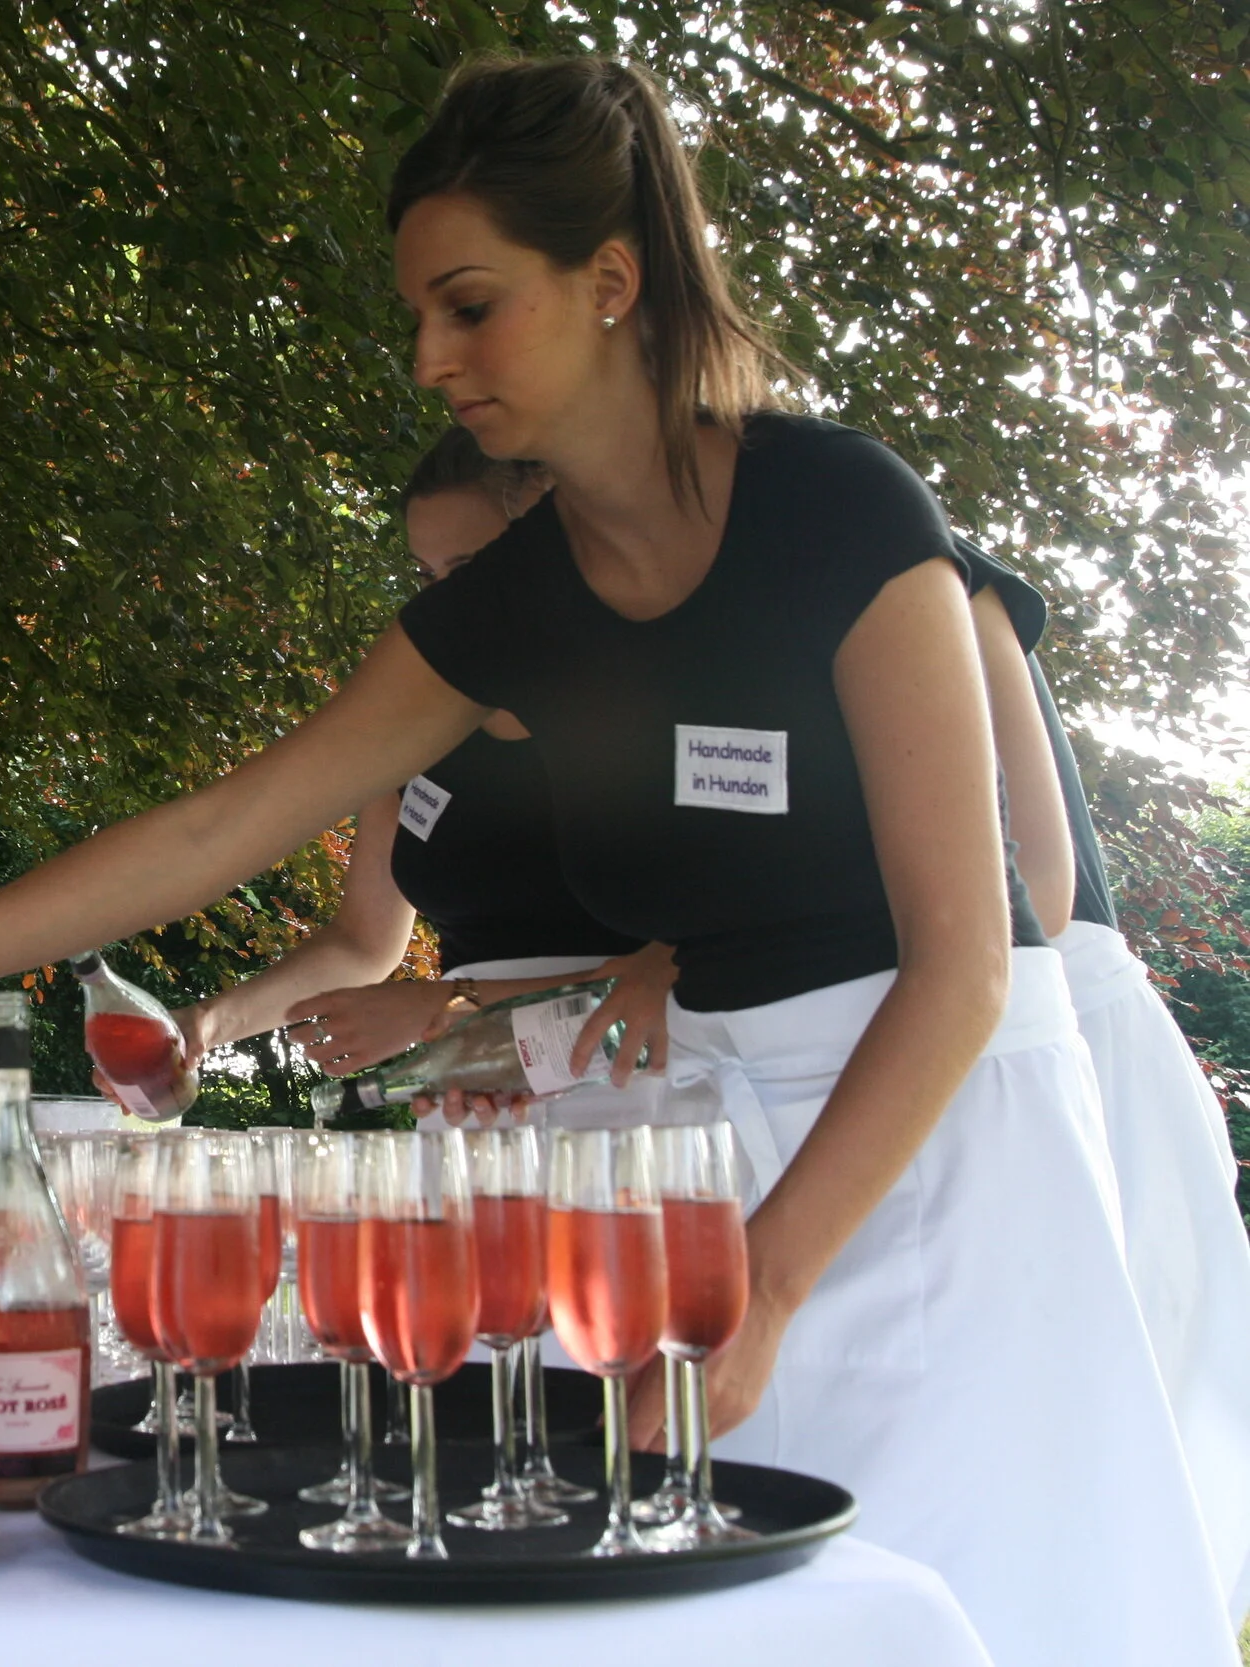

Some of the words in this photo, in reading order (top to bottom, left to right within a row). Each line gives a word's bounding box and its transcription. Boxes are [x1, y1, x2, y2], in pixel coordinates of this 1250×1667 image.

[688, 740, 772, 763] Handmade
[692, 773, 706, 790] in
[709, 774, 768, 797] Hundon
